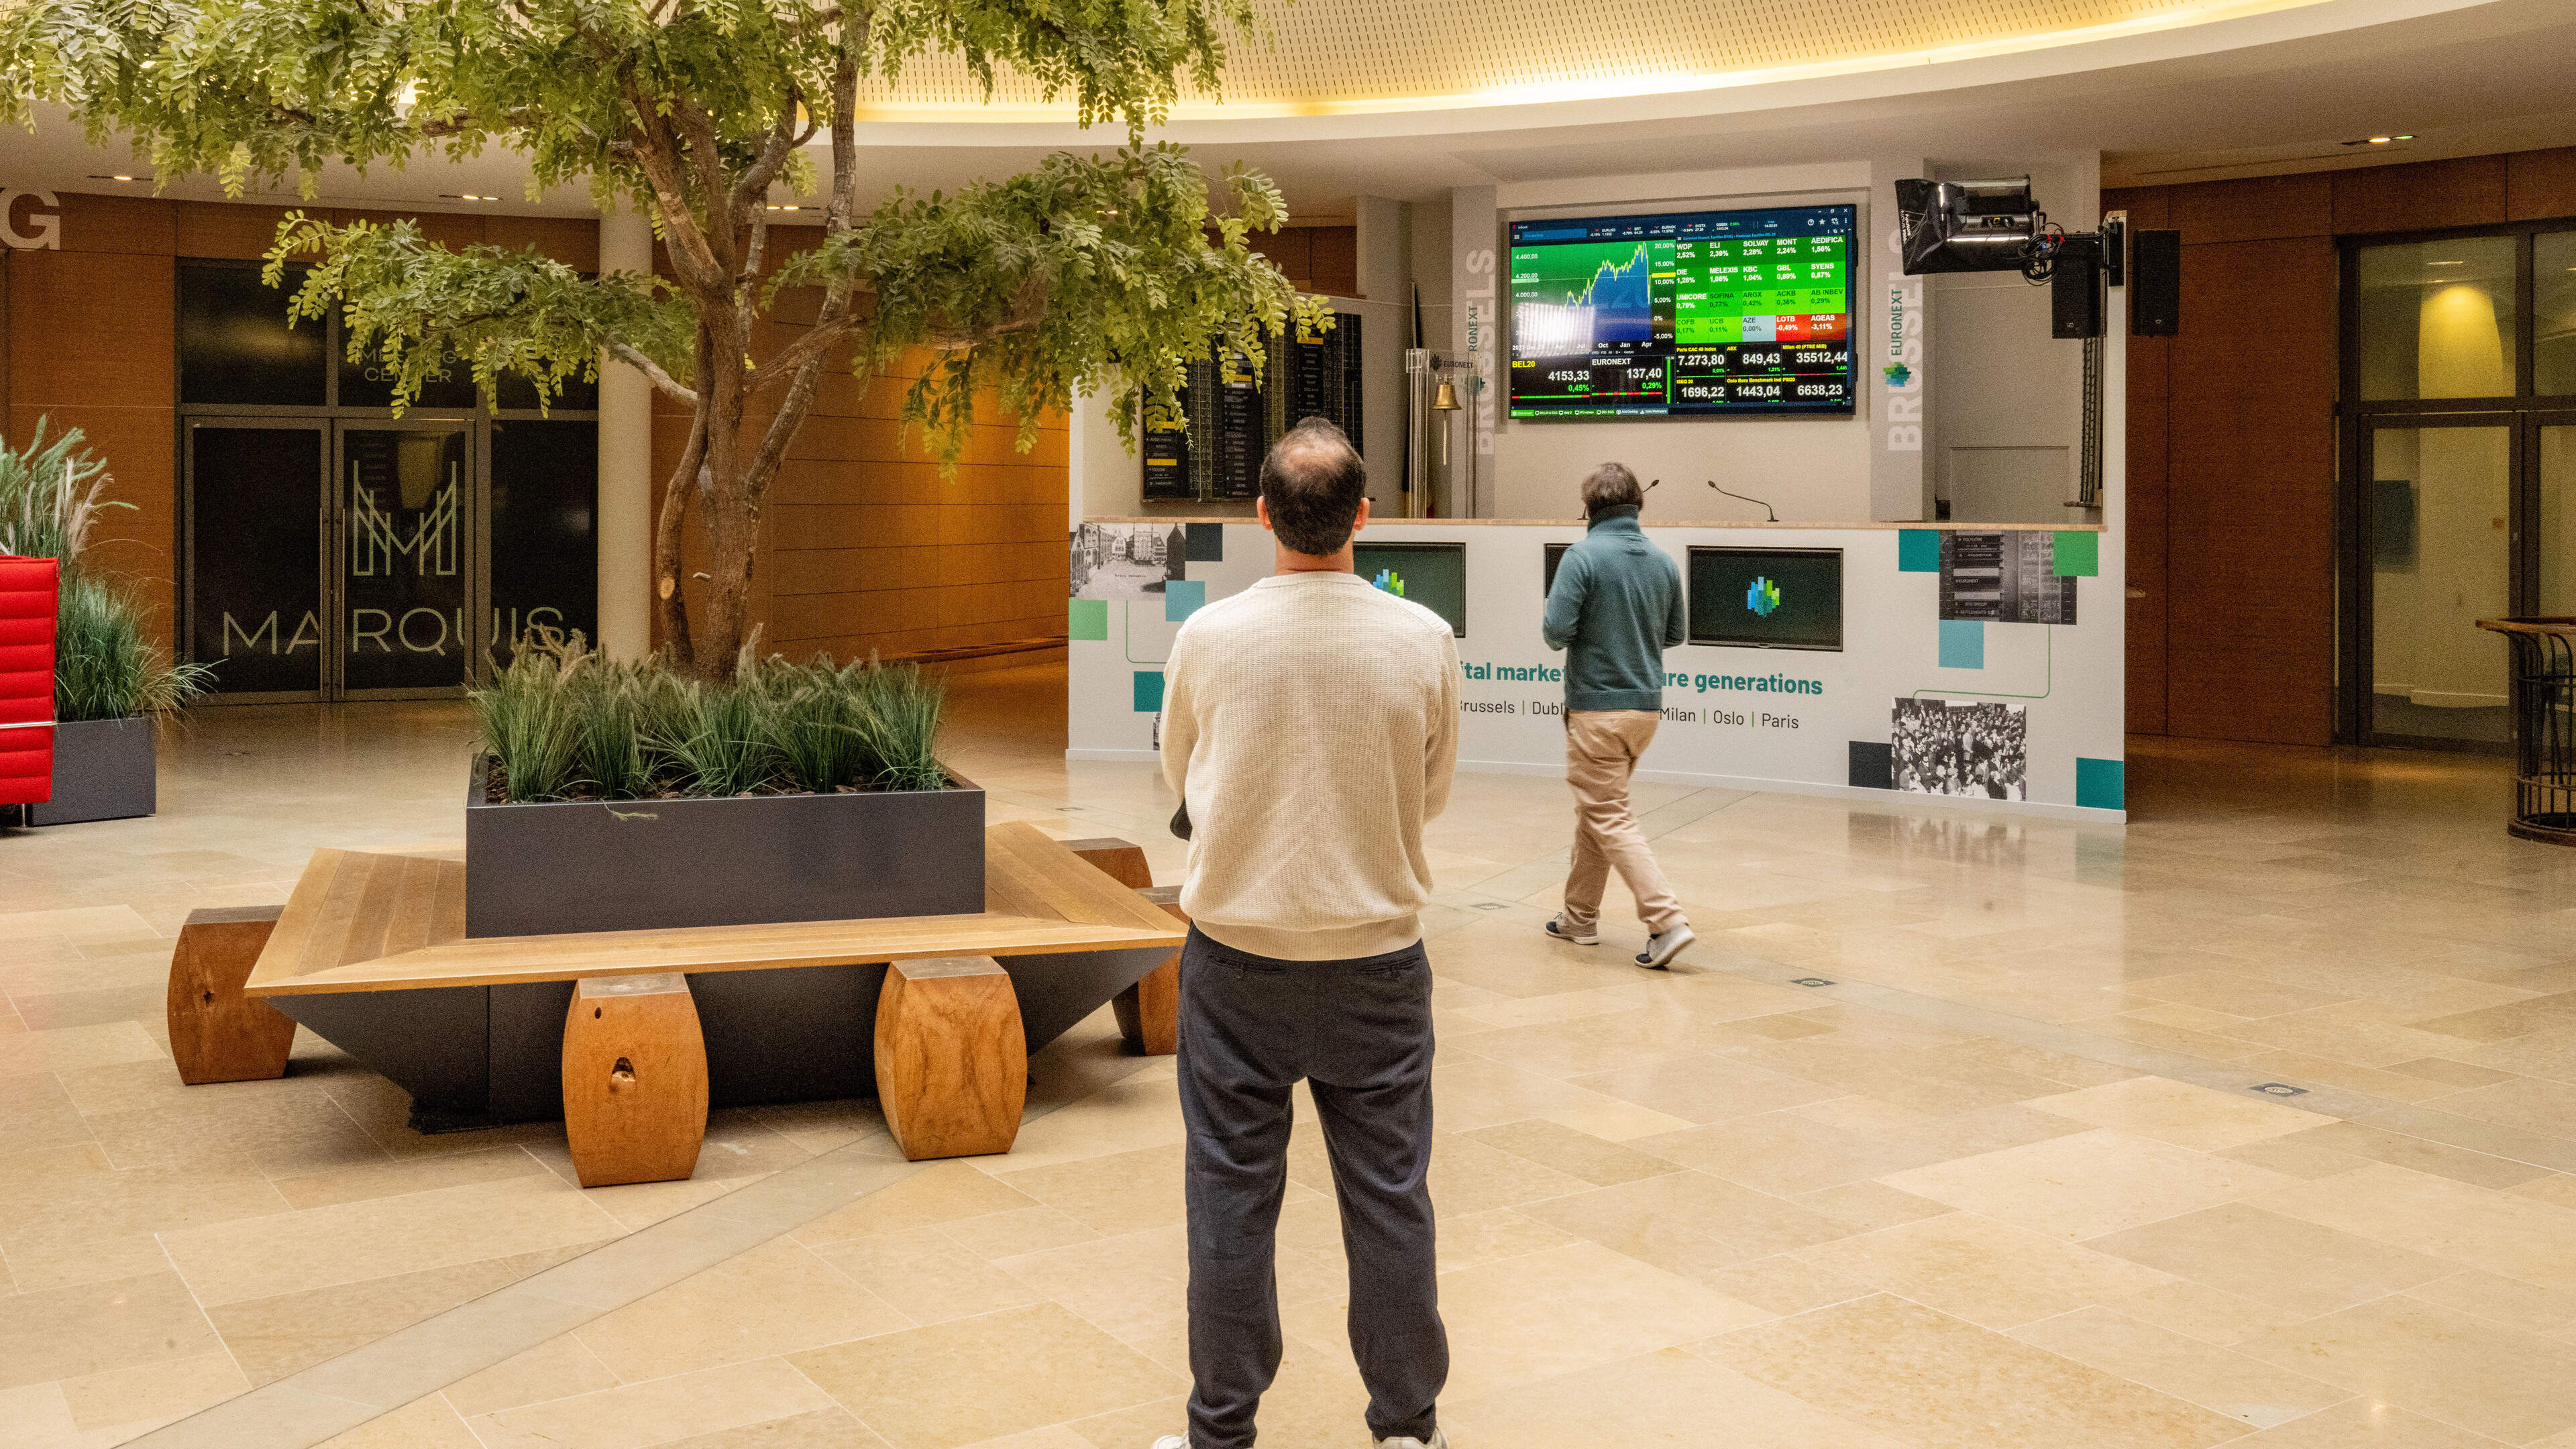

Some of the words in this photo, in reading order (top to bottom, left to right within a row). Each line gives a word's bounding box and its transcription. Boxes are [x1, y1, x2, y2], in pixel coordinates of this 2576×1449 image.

[1890, 288, 1902, 356] EURONEXT
[1468, 305, 1478, 352] RONEXT
[1592, 358, 1631, 366] EURONEXT
[1678, 354, 1725, 366] 7.273,80
[1743, 353, 1780, 365] 849,43
[1796, 352, 1847, 364] 35512,44
[1444, 360, 1474, 369] EURONEXT
[1548, 370, 1590, 382] 4153,33
[1626, 368, 1662, 380] 137,40
[1568, 384, 1590, 392] 0,45%
[1681, 386, 1725, 398] 1696,22
[1736, 385, 1780, 397] 1443,04
[1797, 384, 1843, 396] 6638,23
[223, 606, 566, 656] MARQUIS
[1695, 673, 1823, 694] generations
[1460, 700, 1515, 714] russels
[1532, 702, 1563, 715] Dubl
[1660, 707, 1696, 722] Milan
[1713, 710, 1744, 725] Oslo
[1762, 713, 1799, 729] Paris
